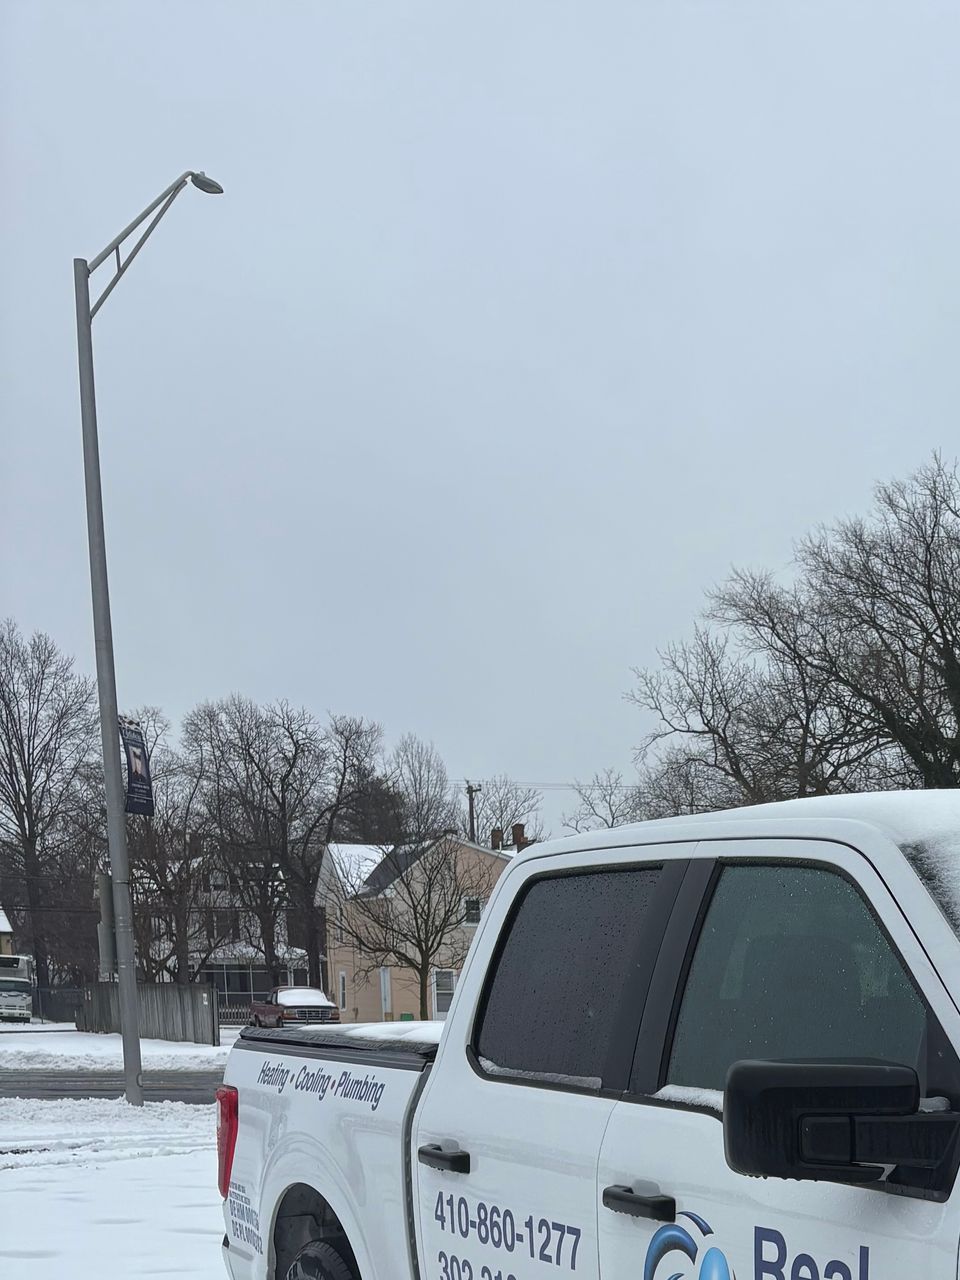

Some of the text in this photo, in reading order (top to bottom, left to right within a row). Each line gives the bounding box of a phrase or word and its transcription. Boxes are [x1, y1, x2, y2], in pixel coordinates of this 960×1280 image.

[257, 1061, 386, 1111] Heating Cooling Plumbing
[434, 1191, 581, 1270] 410-860-1277
